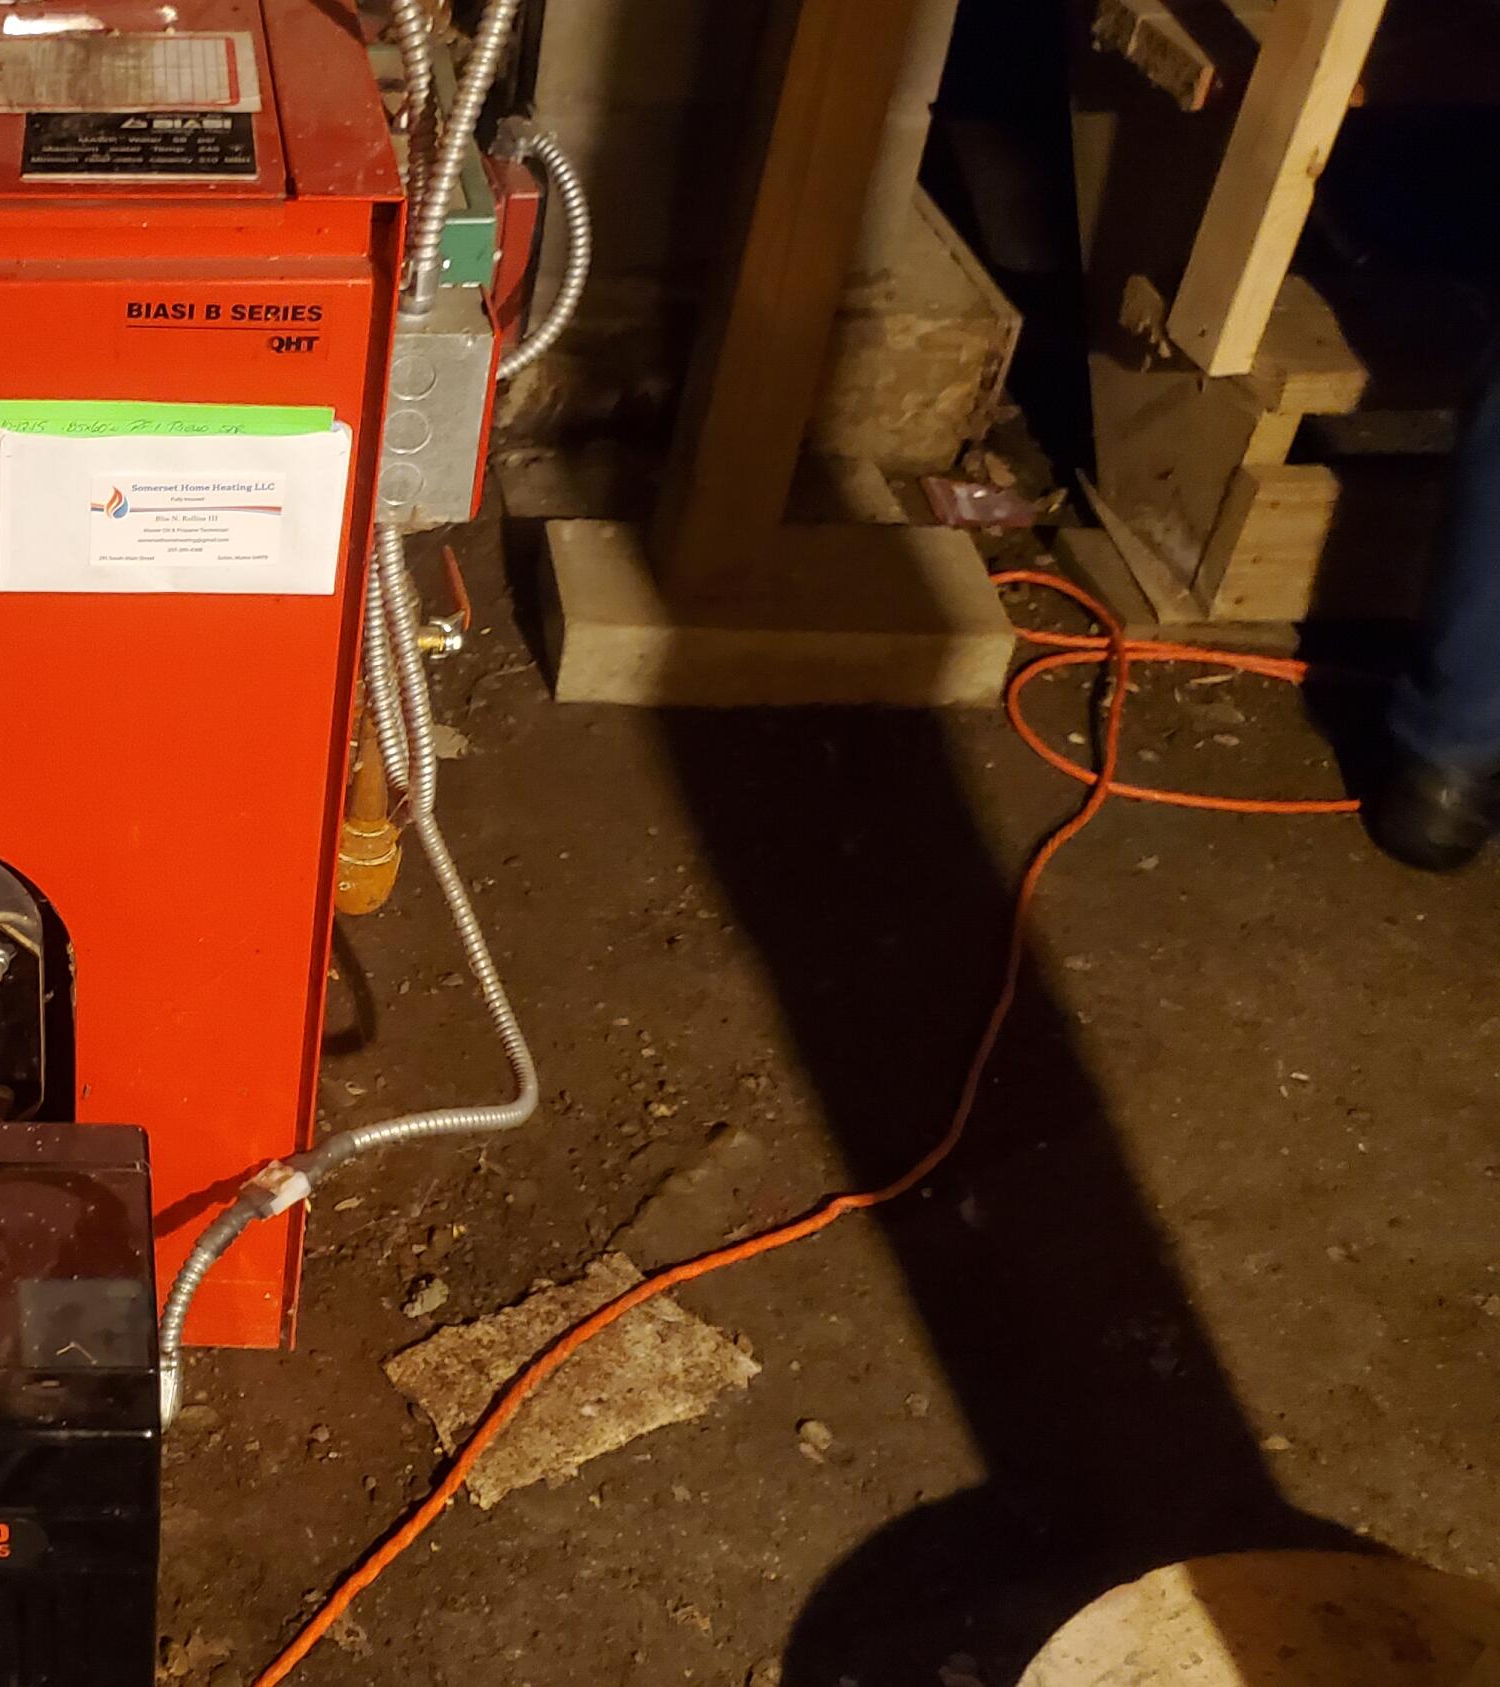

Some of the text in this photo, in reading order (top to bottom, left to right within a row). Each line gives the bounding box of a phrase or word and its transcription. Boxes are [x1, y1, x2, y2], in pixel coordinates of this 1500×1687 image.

[126, 302, 323, 322] BIASI B SERIES
[269, 335, 320, 353] QHT
[131, 482, 276, 493] Somerset Home Heating LLC
